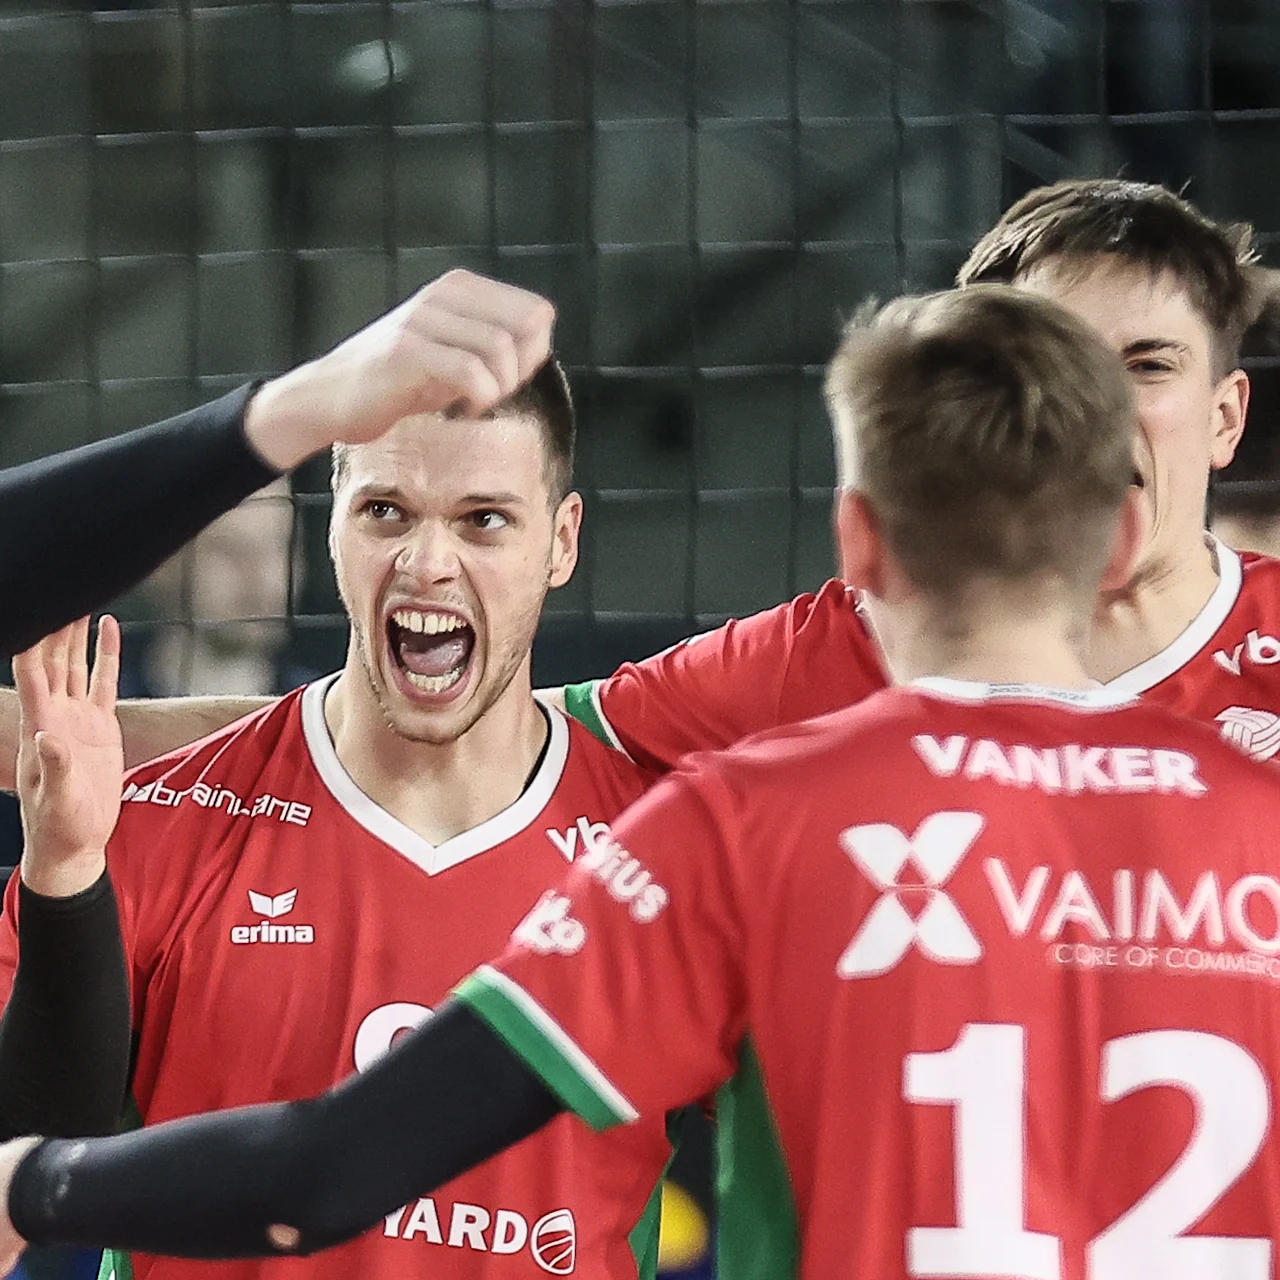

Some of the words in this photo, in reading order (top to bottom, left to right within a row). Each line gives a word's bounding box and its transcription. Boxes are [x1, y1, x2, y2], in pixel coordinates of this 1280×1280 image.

[913, 734, 1209, 796] VANKER
[231, 920, 315, 944] erima
[1053, 943, 1119, 967] CORE
[1125, 945, 1160, 970] OF
